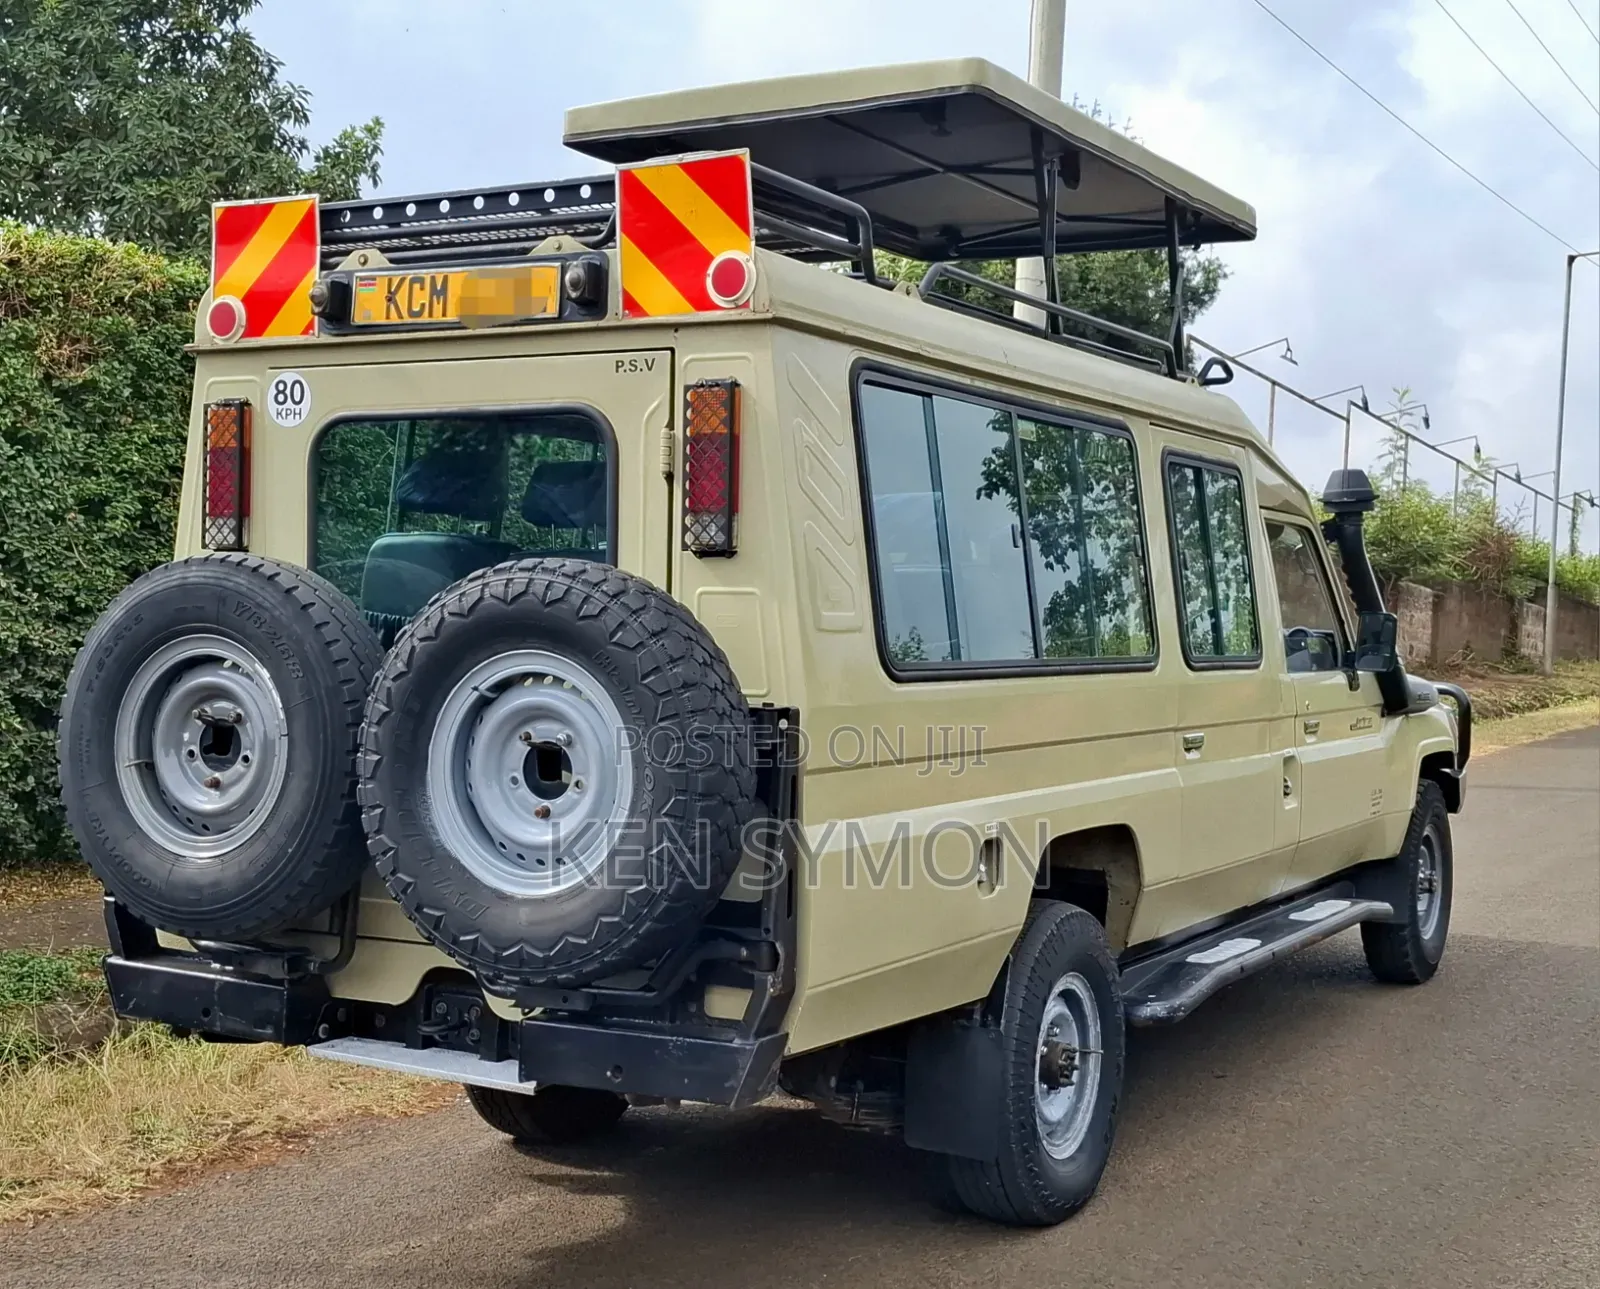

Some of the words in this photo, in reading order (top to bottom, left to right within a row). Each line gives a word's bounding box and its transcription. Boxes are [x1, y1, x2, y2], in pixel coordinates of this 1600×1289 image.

[385, 274, 449, 320] KCM
[615, 357, 656, 374] P.S.V
[273, 379, 305, 406] 80
[275, 407, 302, 420] KPH
